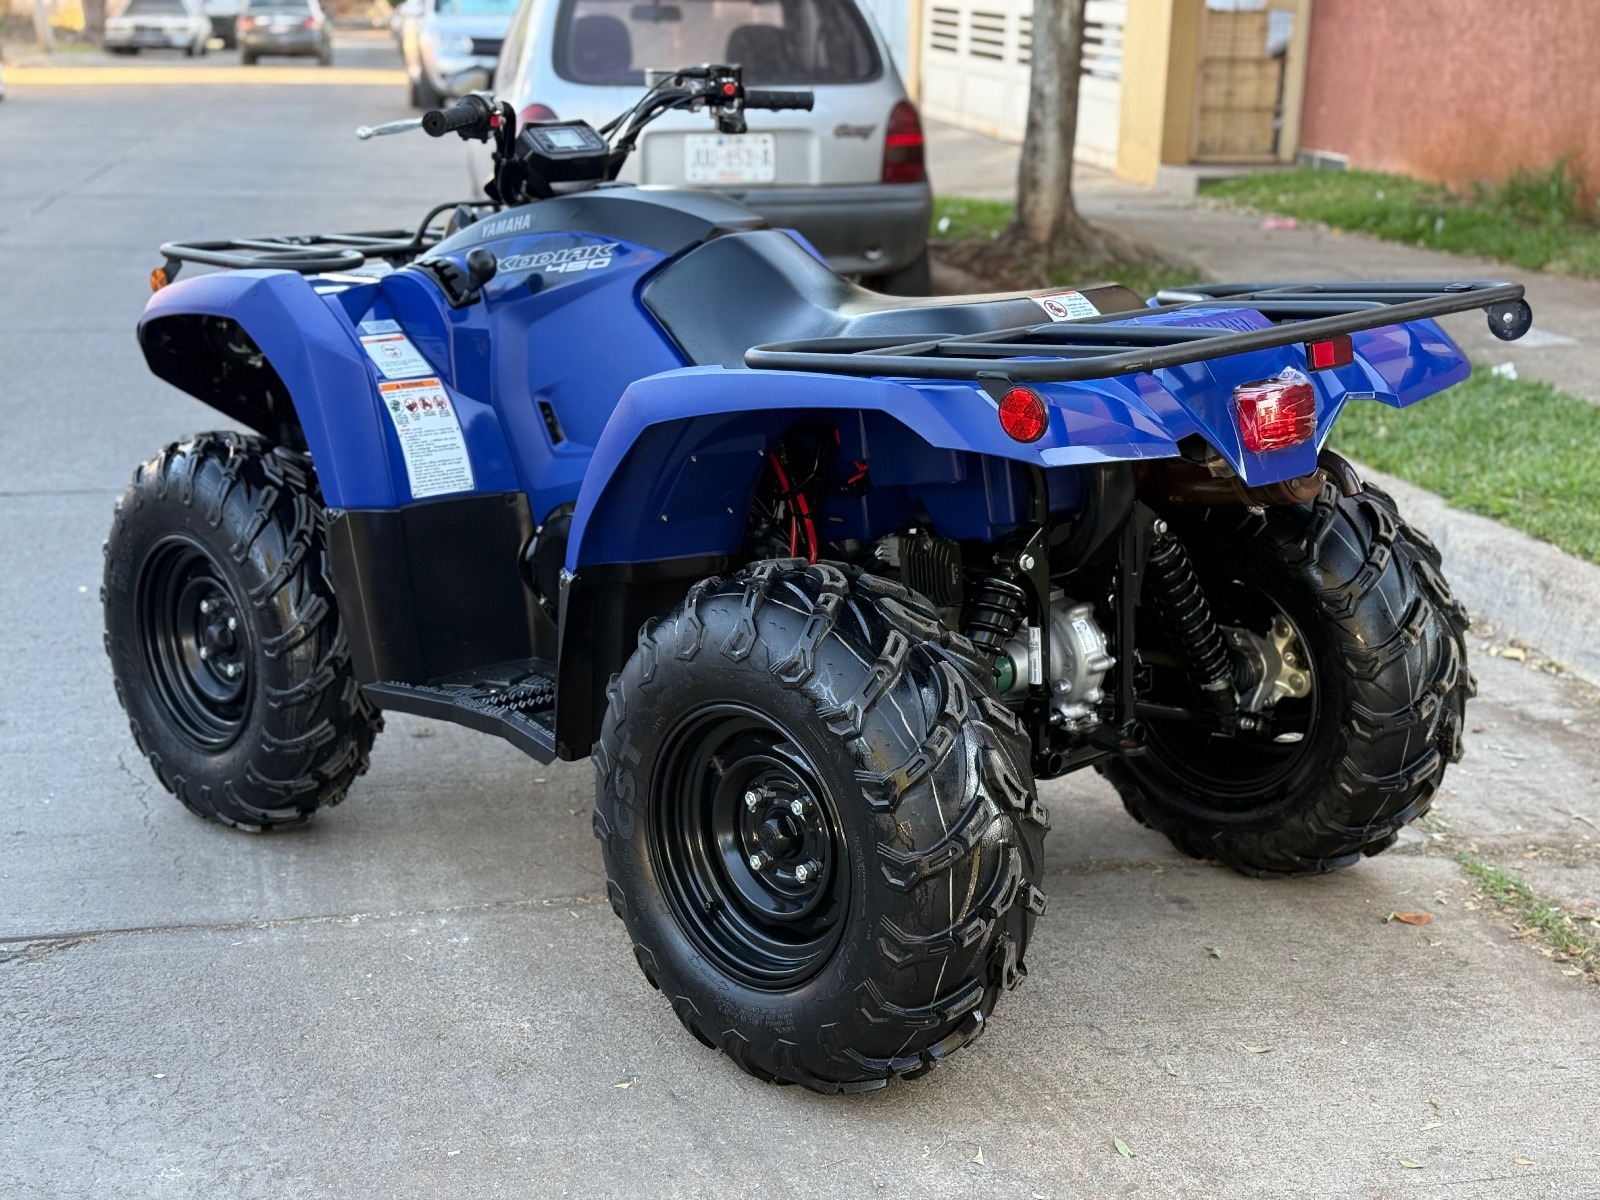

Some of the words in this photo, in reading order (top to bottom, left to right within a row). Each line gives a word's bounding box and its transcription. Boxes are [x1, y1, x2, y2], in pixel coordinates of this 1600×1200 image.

[481, 214, 531, 238] YAMAHA
[496, 242, 620, 273] KODIAK
[545, 257, 612, 274] 450
